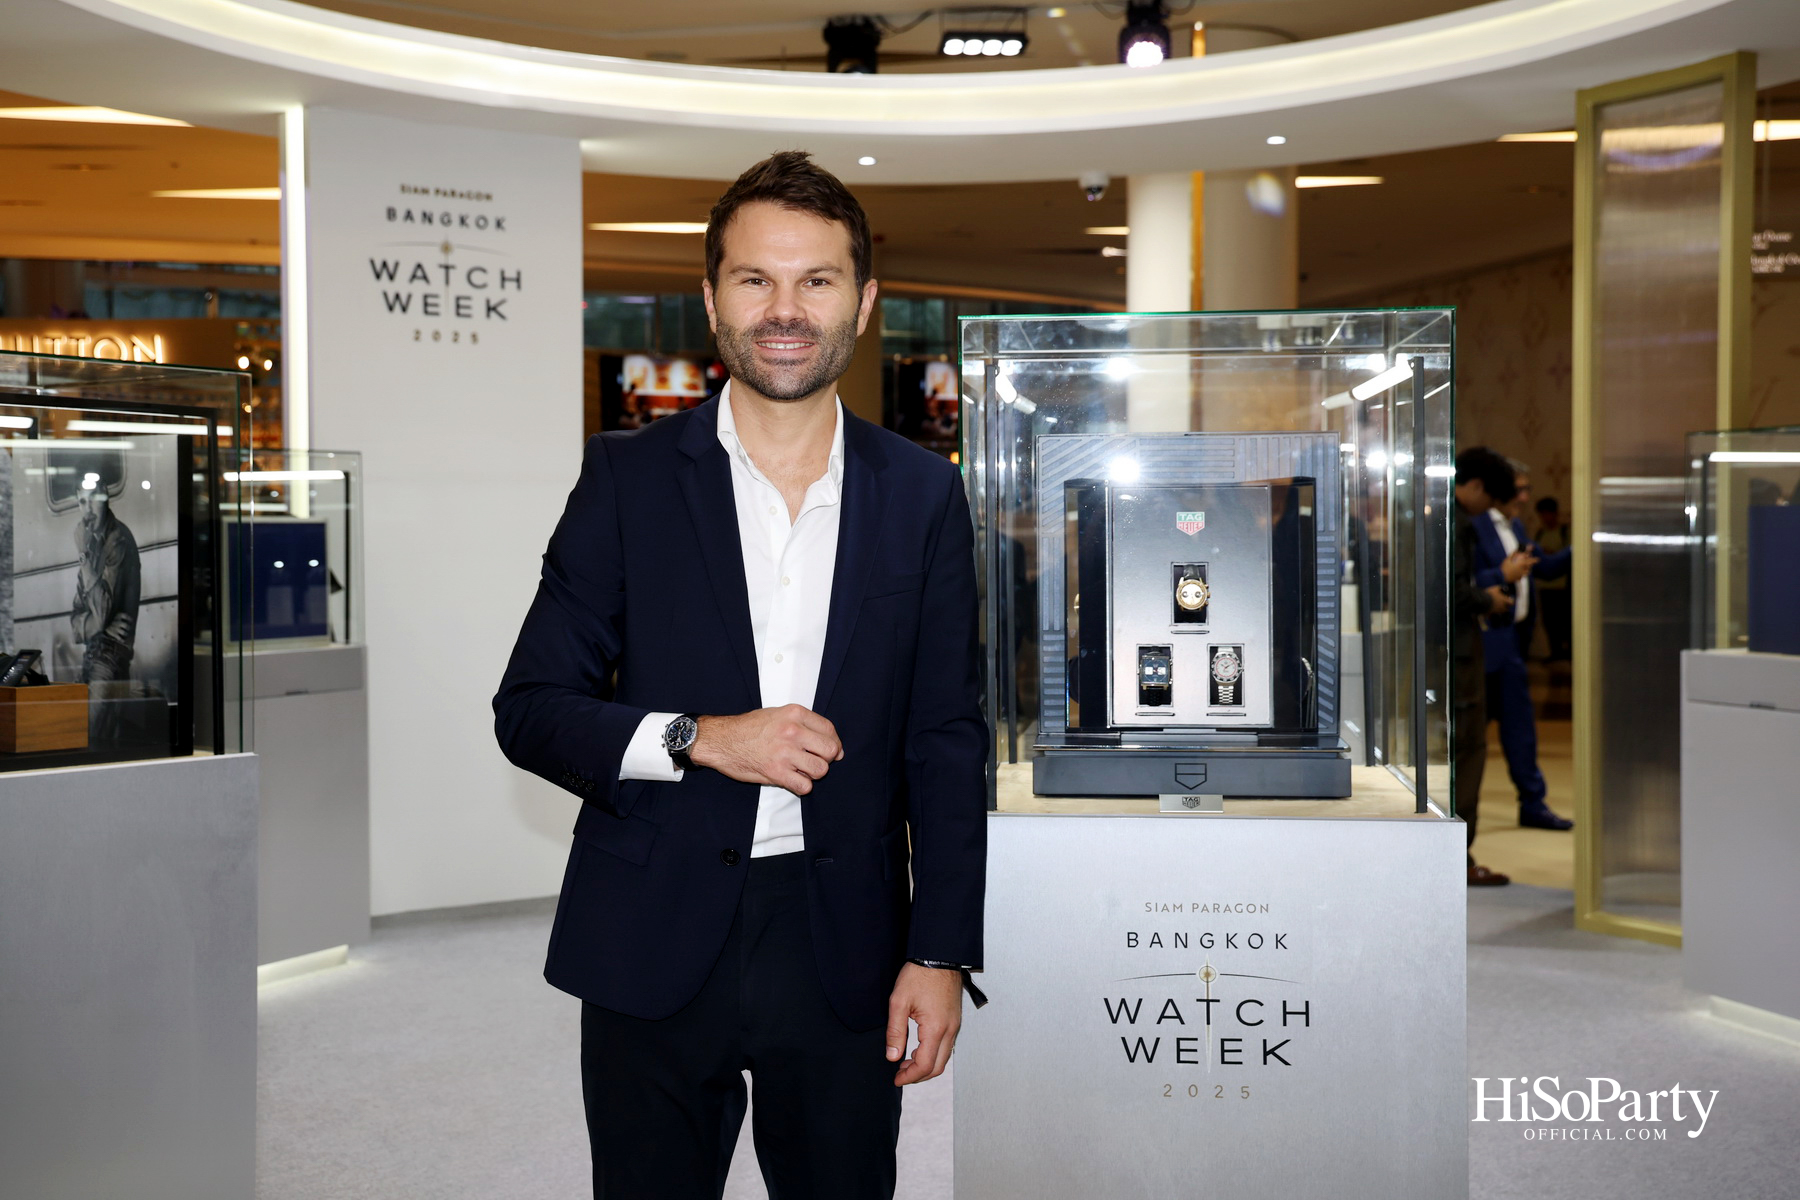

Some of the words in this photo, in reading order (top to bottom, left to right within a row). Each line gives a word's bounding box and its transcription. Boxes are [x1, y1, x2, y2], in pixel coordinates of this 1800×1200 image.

[386, 206, 506, 231] BANGKOK
[369, 257, 522, 291] WATCH
[382, 290, 508, 321] WEEK
[412, 328, 479, 345] 2025
[1179, 513, 1202, 521] TAG
[1178, 522, 1203, 534] HEUER
[1144, 902, 1183, 913] SIAM
[1192, 903, 1270, 914] PARAGON
[1127, 932, 1288, 950] BANGKOK
[1104, 998, 1310, 1027] WATCH
[1121, 1036, 1292, 1066] WEEK
[1163, 1084, 1250, 1100] 2025
